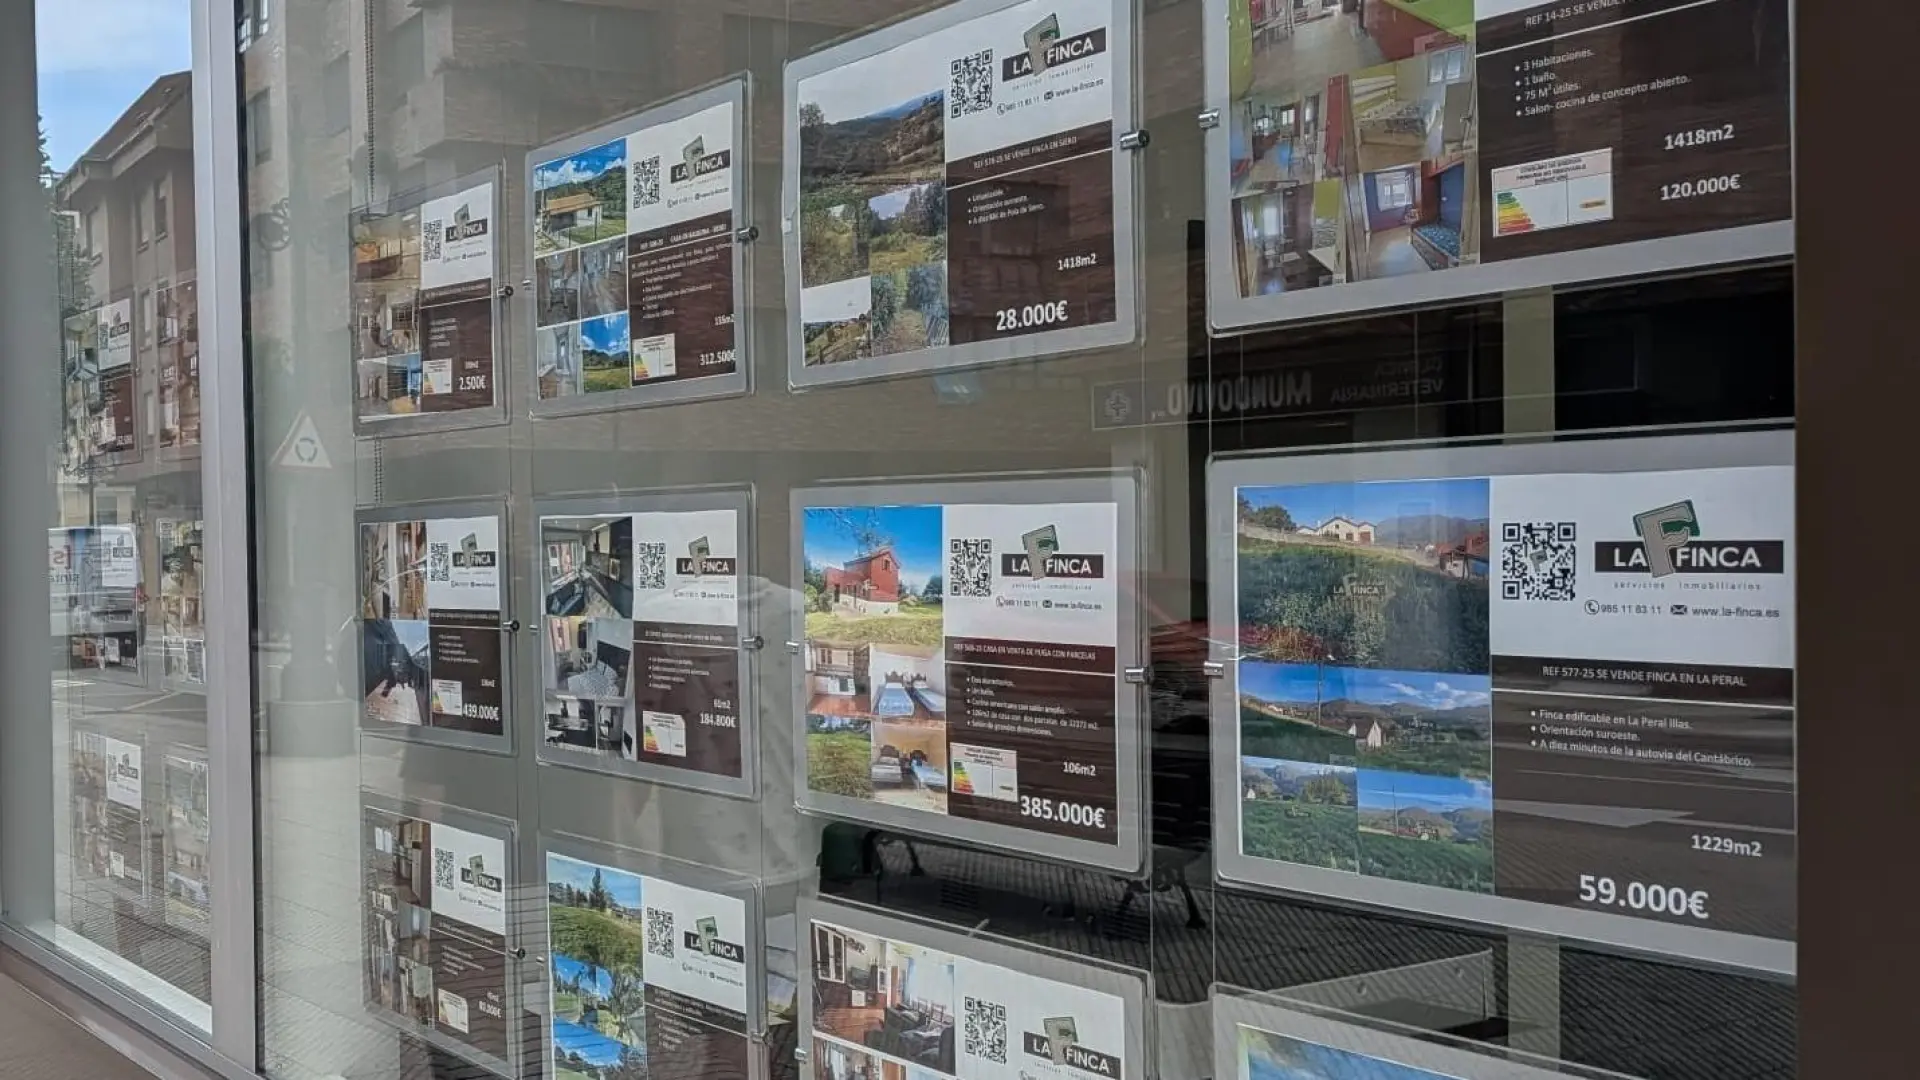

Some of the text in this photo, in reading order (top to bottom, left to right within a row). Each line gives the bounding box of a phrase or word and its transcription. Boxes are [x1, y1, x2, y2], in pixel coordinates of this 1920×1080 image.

[1525, 13, 1544, 28] REF
[1545, 7, 1572, 23] 14-25
[1572, 3, 1587, 15] SE
[1012, 55, 1033, 75] LA
[1047, 37, 1094, 65] FINCA
[1523, 48, 1596, 72] 3 Habitaciones.
[1524, 70, 1558, 86] 1 baño.
[1524, 89, 1537, 101] 75
[1555, 95, 1586, 110] cocina
[1587, 92, 1601, 104] de
[1602, 83, 1649, 103] concepto
[1650, 73, 1693, 91] abierto.
[1663, 124, 1736, 151] 1418m2
[1660, 173, 1742, 202] 120.000€
[1057, 252, 1097, 271] 1418m2
[996, 300, 1069, 332] 28.000€
[702, 560, 730, 574] FINCA
[1012, 557, 1093, 575] LA FINCA
[1614, 546, 1762, 568] LA FINCA
[1691, 605, 1781, 619] www.la-finca.es
[1542, 665, 1748, 688] REF 577-25 SE VENDE FINCA EN LA PERAL
[1539, 709, 1564, 721] Finca
[1565, 710, 1612, 725] edificable
[1613, 715, 1627, 725] en
[1627, 715, 1640, 727] La
[1640, 716, 1668, 729] Peral
[1539, 723, 1642, 742] Orientación suroeste.
[1540, 739, 1549, 751] A
[1549, 740, 1569, 752] diez
[1570, 741, 1608, 755] minutos
[1609, 744, 1623, 756] de
[1625, 745, 1635, 757] la
[1675, 749, 1693, 763] del
[1693, 751, 1755, 768] Cantábrico.
[1063, 761, 1097, 778] 106m2
[1020, 795, 1107, 830] 385.000€
[1691, 834, 1763, 857] 1229m2
[1579, 873, 1710, 919] 59.000€
[1033, 1038, 1052, 1055] LA
[1066, 1046, 1111, 1074] FINCA
